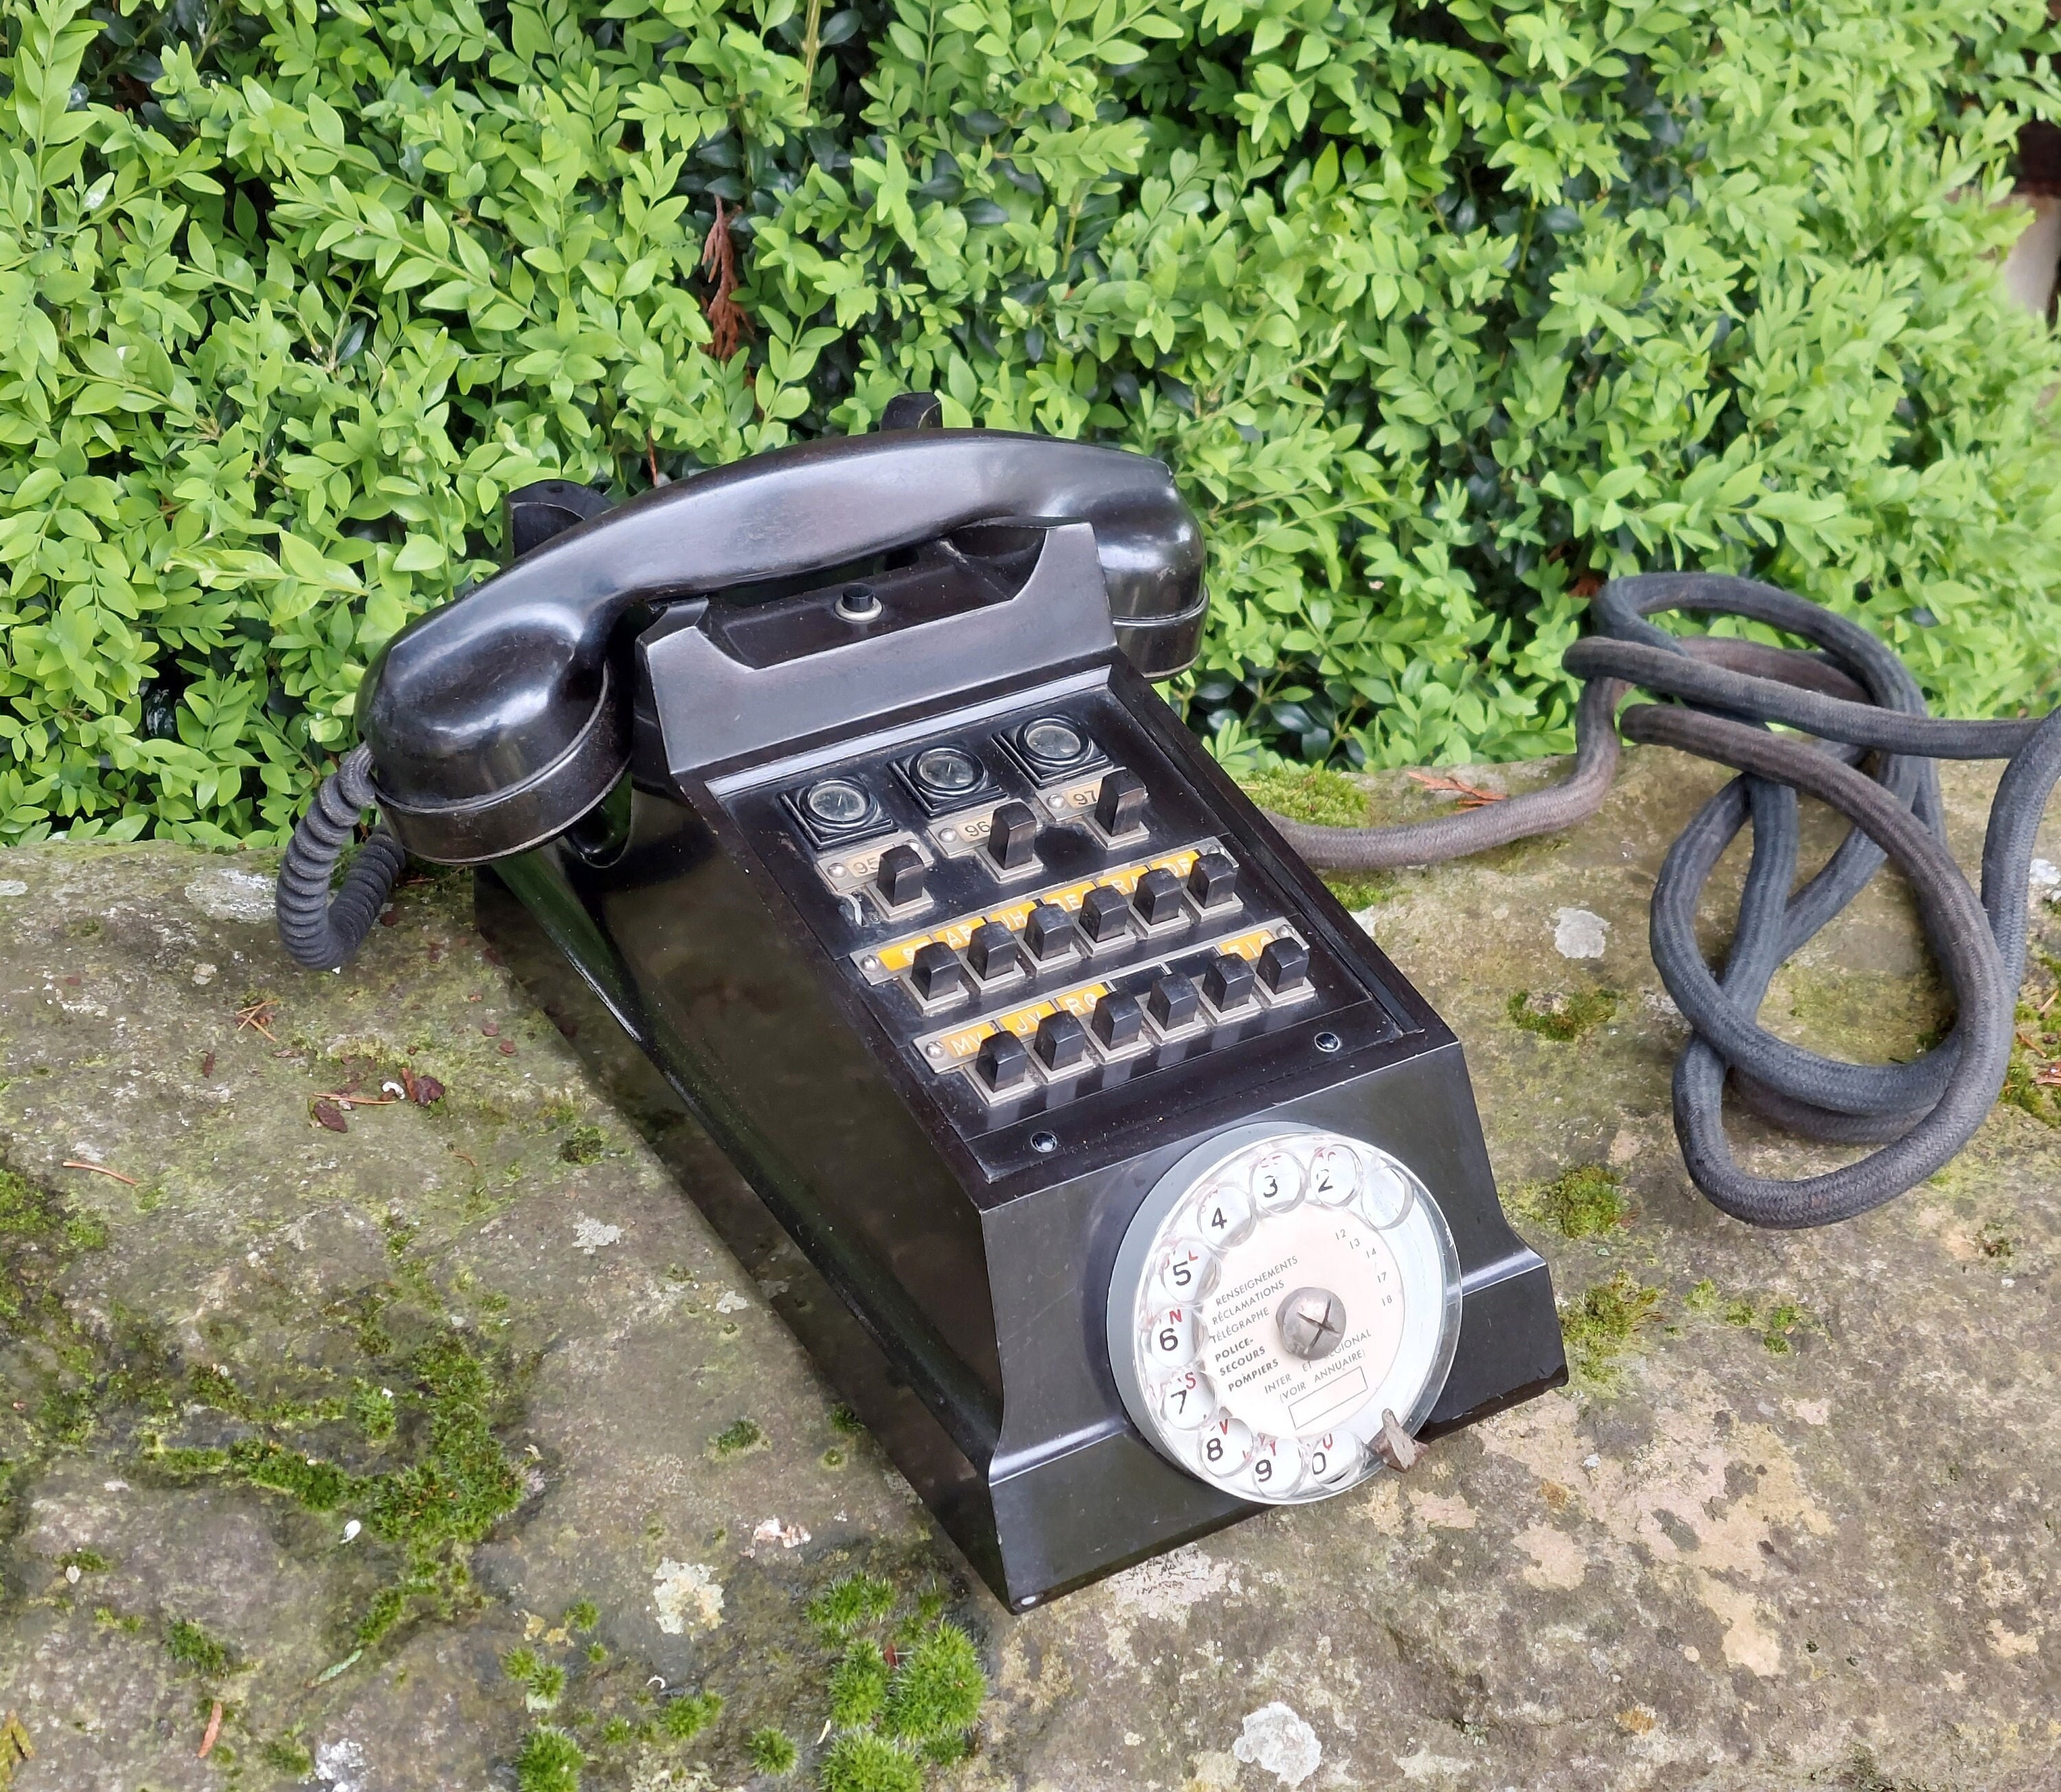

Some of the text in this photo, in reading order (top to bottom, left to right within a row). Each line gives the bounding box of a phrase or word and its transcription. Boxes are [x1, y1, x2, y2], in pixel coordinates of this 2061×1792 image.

[1072, 790, 1098, 805] 97
[965, 821, 991, 837] 96
[853, 857, 879, 874] 95
[1263, 1175, 1278, 1198] 3
[1316, 1169, 1333, 1192] 2
[1211, 1207, 1228, 1229] 4
[1336, 1229, 1347, 1240] 12
[1350, 1238, 1360, 1249] 13
[1366, 1247, 1377, 1259] 14
[1173, 1260, 1191, 1286] 5
[1215, 1256, 1298, 1306] RENSEIGNEMENTS
[1377, 1271, 1386, 1283] 17
[1212, 1280, 1285, 1325] RÉCLAMATIONS
[1382, 1295, 1393, 1306] 18
[1169, 1308, 1182, 1325] N
[1211, 1307, 1270, 1343] TÉLÉGRAPHE
[1160, 1328, 1178, 1351] 6
[1215, 1337, 1254, 1362] POLICE-
[1219, 1346, 1265, 1376] SECOURS
[1185, 1372, 1196, 1390] S
[1228, 1359, 1279, 1392] POMPIERS
[1265, 1374, 1292, 1394] INTER
[1279, 1349, 1366, 1403] (VOIR ANNUAIRE)
[1171, 1390, 1187, 1415] 7
[1219, 1418, 1228, 1436] V
[1206, 1438, 1223, 1462] 8
[1255, 1460, 1272, 1482] 9
[1311, 1452, 1327, 1475] 0
